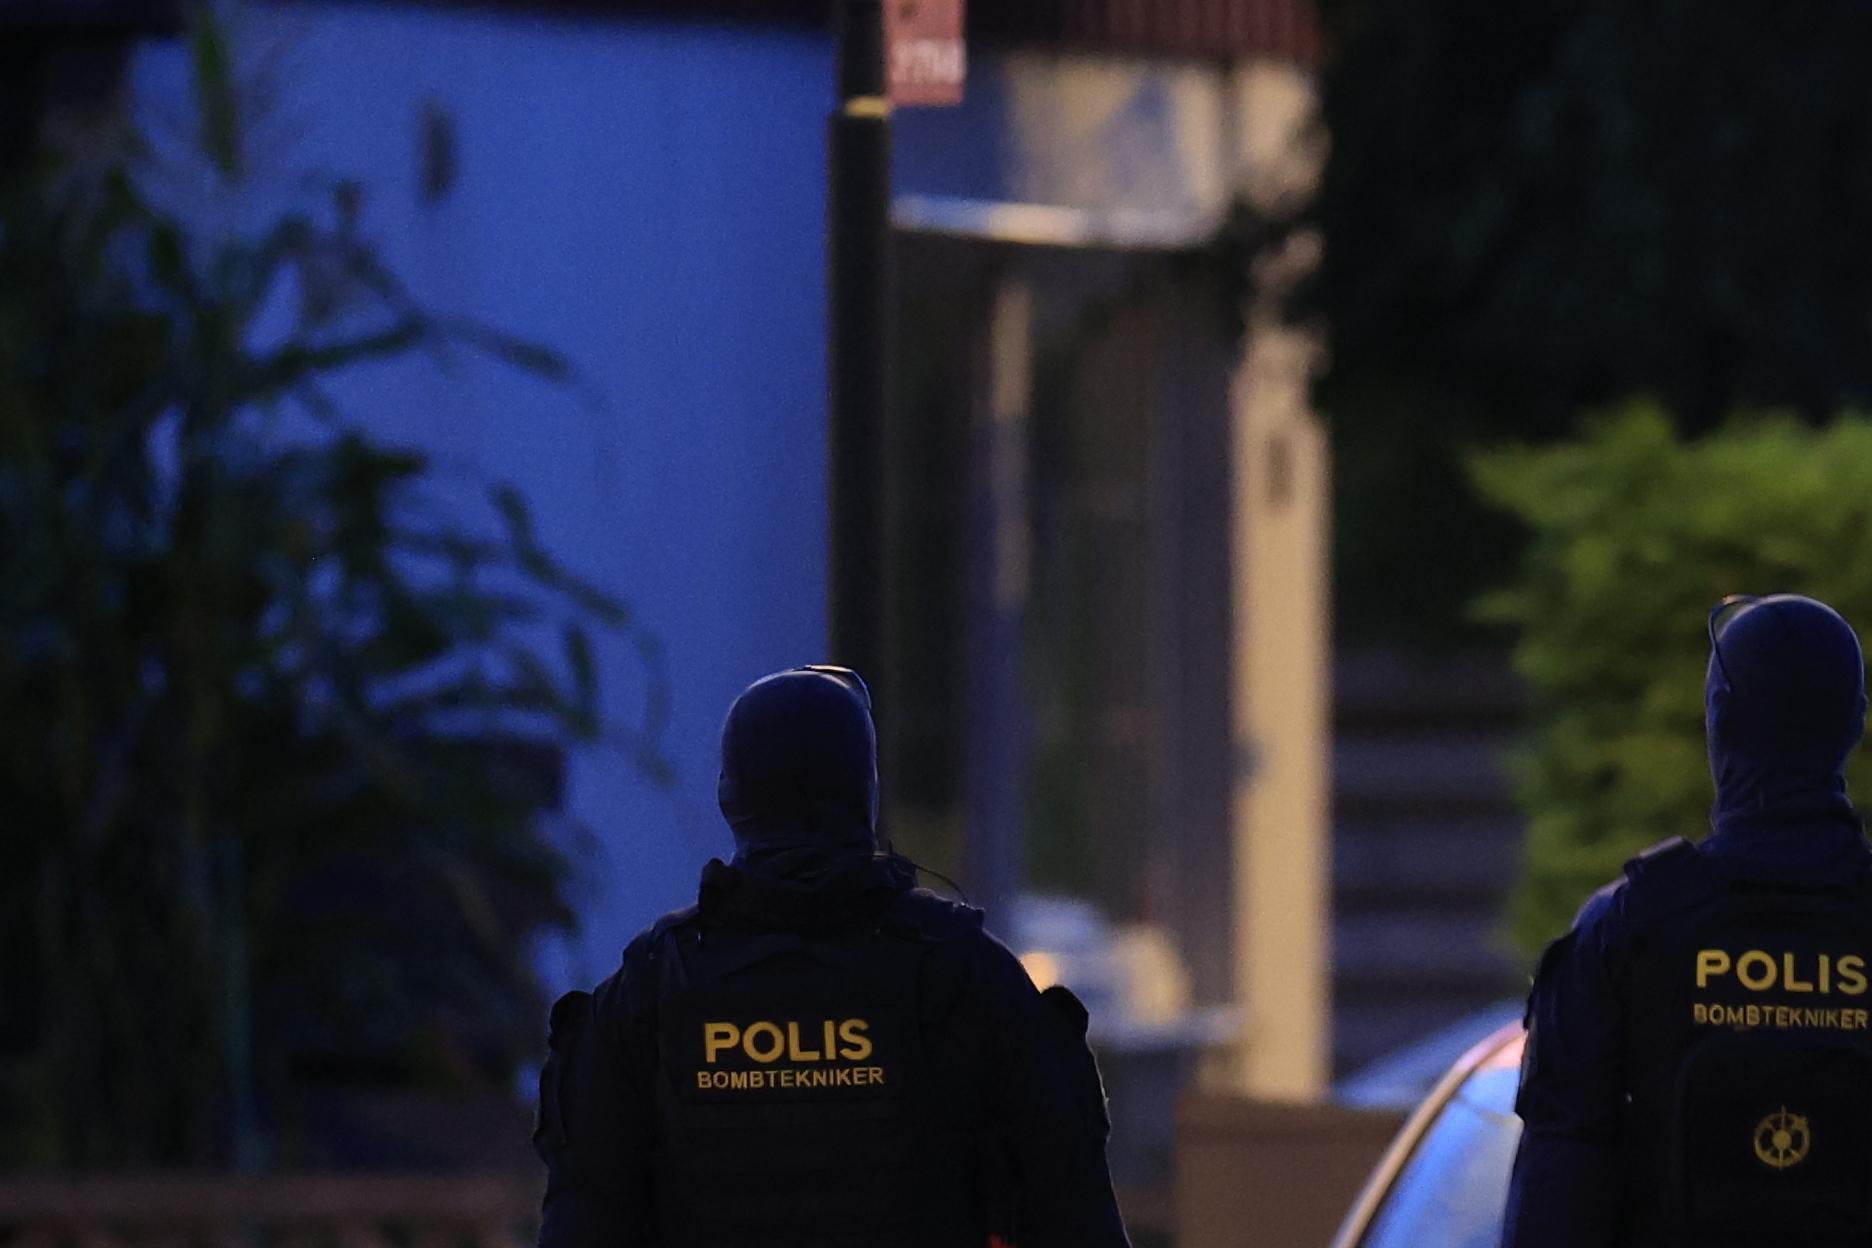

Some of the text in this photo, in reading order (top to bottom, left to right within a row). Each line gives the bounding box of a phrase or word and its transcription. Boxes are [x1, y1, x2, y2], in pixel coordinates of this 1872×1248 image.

[1695, 948, 1869, 996] POLIS
[1692, 1002, 1869, 1031] BOMBTEKNIKER
[703, 1018, 874, 1064] POLIS
[696, 1066, 885, 1091] BOMBTEKNIKER
